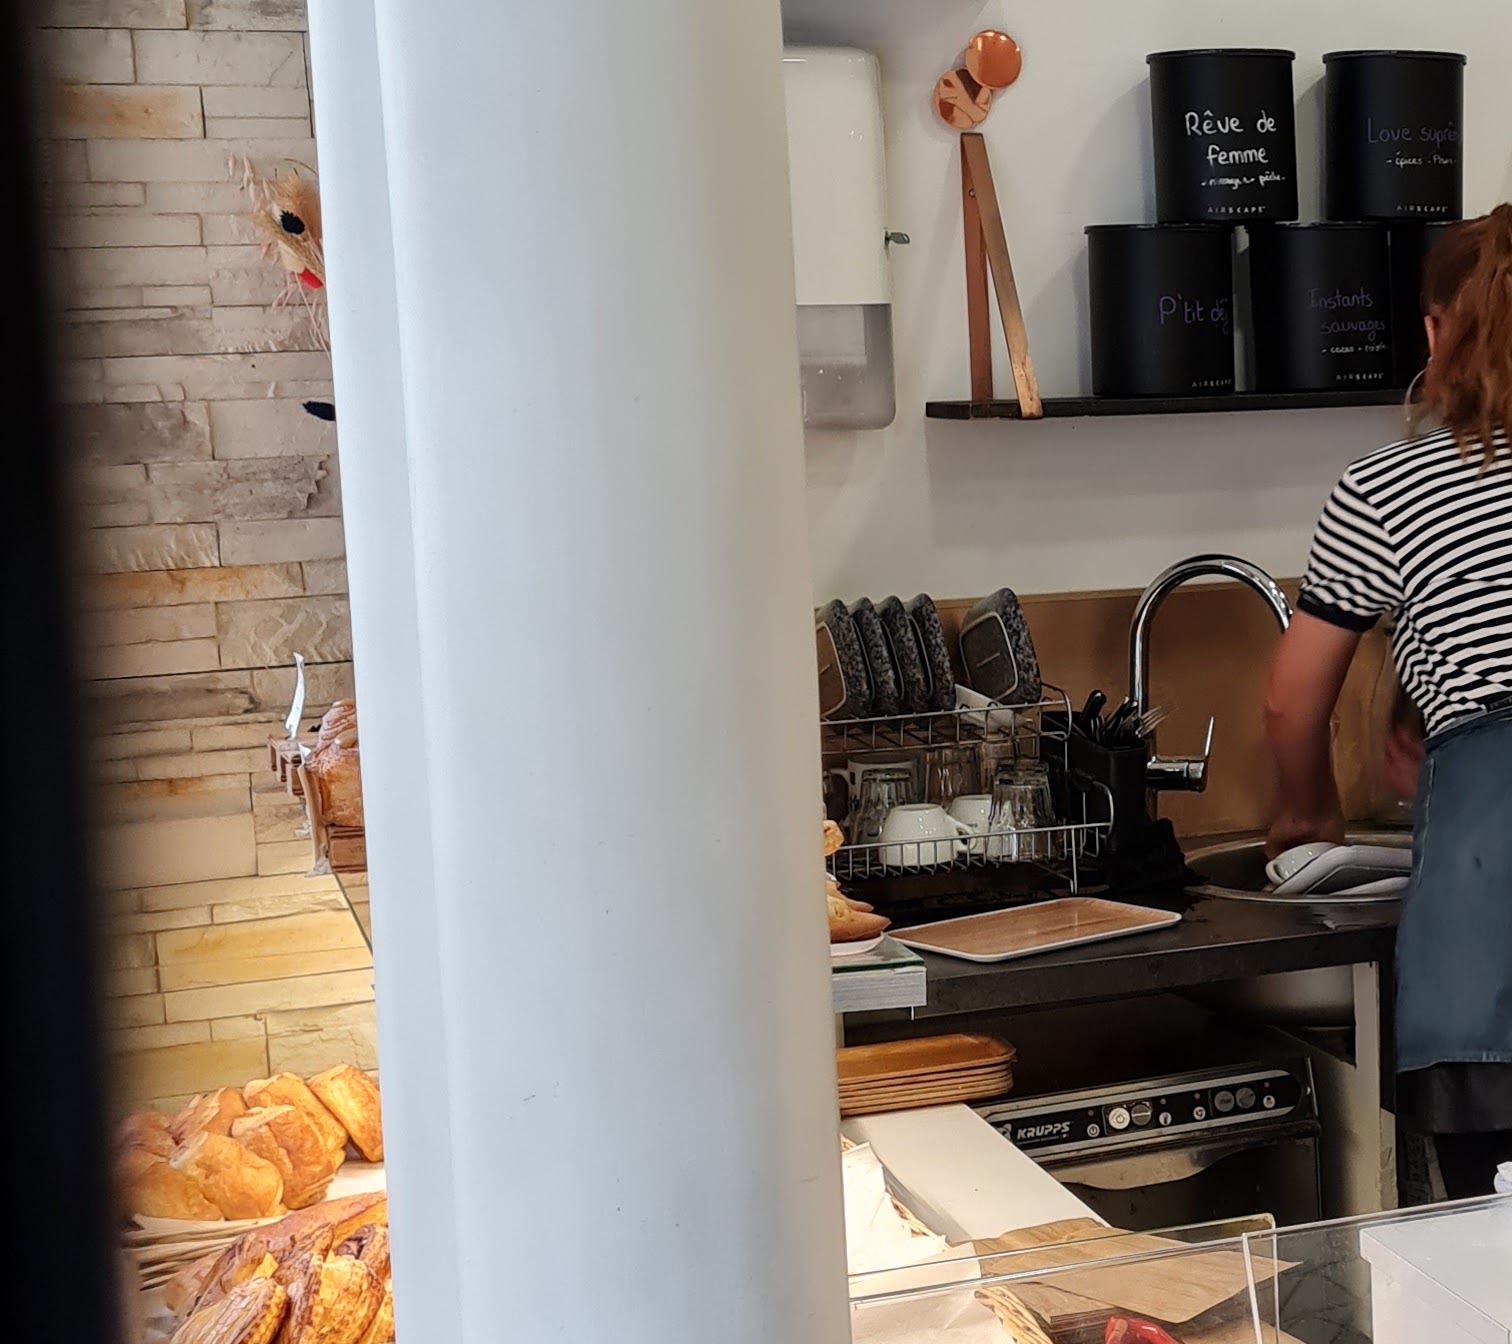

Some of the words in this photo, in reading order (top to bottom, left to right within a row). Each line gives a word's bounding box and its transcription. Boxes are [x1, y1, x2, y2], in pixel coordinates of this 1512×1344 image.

[1185, 110, 1244, 136] Rêve
[1256, 110, 1278, 134] de
[1366, 117, 1411, 144] Love
[1206, 144, 1269, 167] femme
[1309, 286, 1374, 310] Instants
[1319, 319, 1386, 342] sauvages
[1017, 1121, 1071, 1140] KRUPPS
